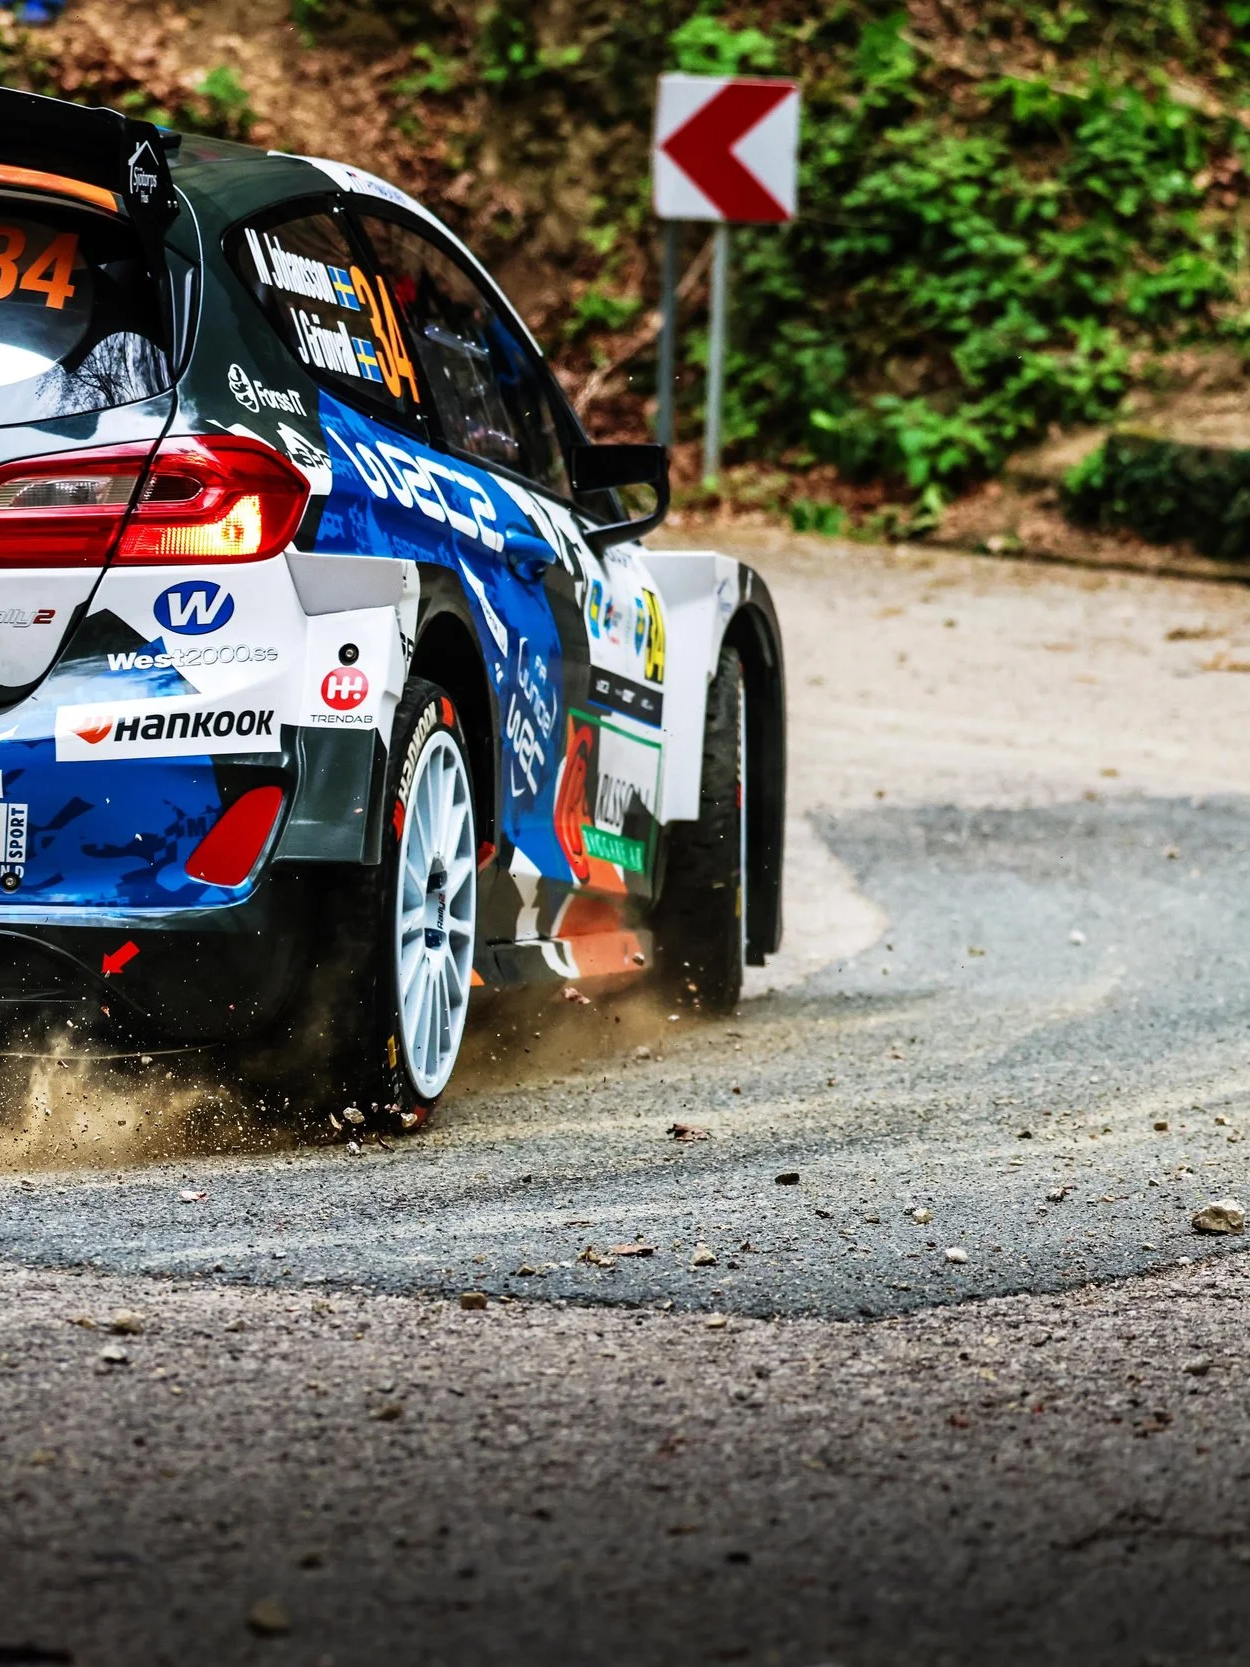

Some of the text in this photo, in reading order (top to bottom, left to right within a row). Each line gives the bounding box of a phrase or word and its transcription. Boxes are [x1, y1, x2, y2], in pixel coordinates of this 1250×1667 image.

[263, 231, 338, 305] Johansson
[350, 265, 420, 404] 34
[310, 714, 374, 724] TRENDAB
[8, 807, 26, 859] SPORT
